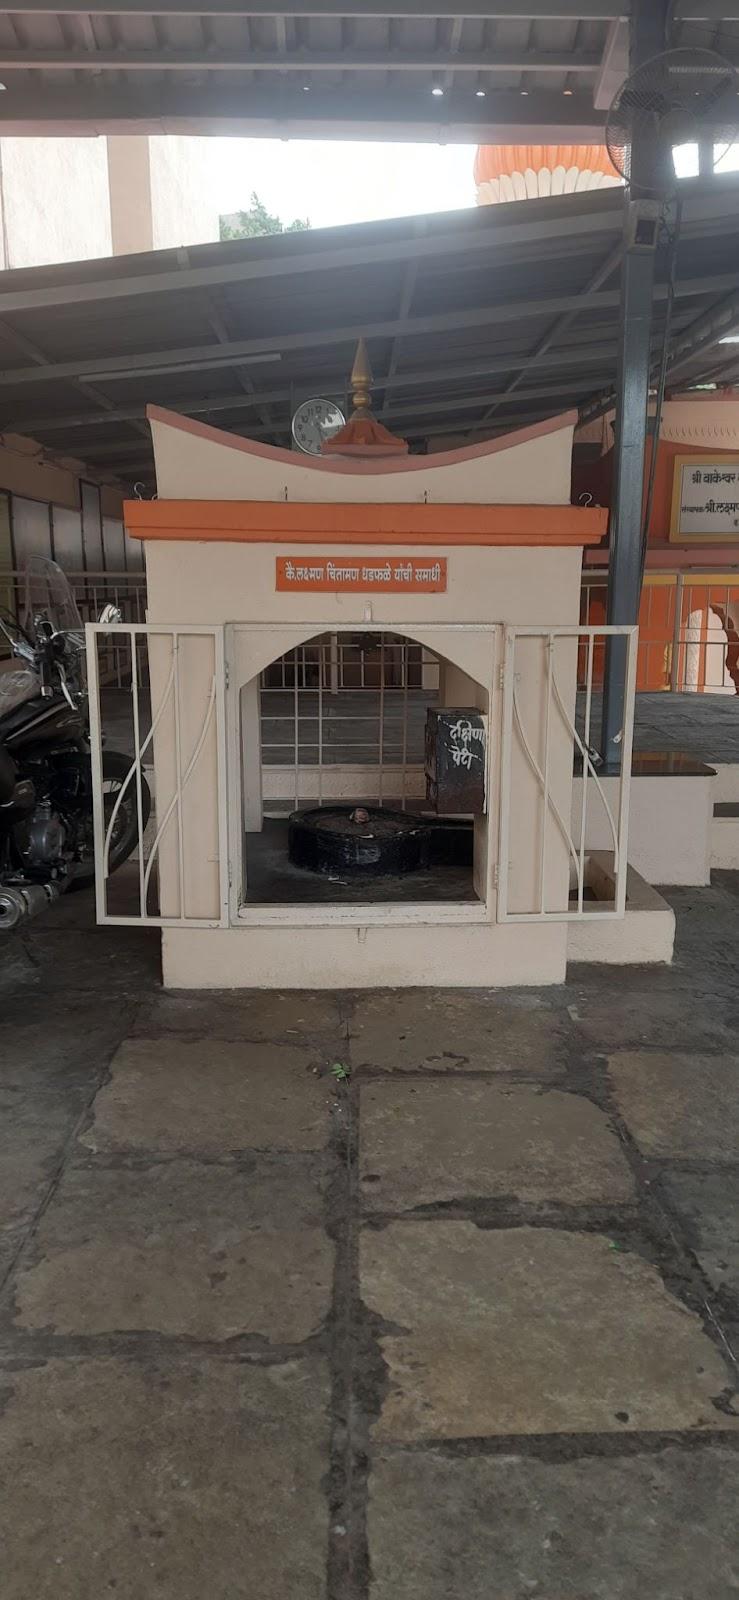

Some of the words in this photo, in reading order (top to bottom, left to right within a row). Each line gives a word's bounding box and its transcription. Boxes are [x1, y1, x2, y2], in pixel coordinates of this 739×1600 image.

[691, 470, 702, 484] श्री
[326, 562, 360, 582] चिंतामण
[362, 563, 391, 582] धडफळे
[394, 563, 413, 582] यांची
[415, 563, 441, 582] समाधी
